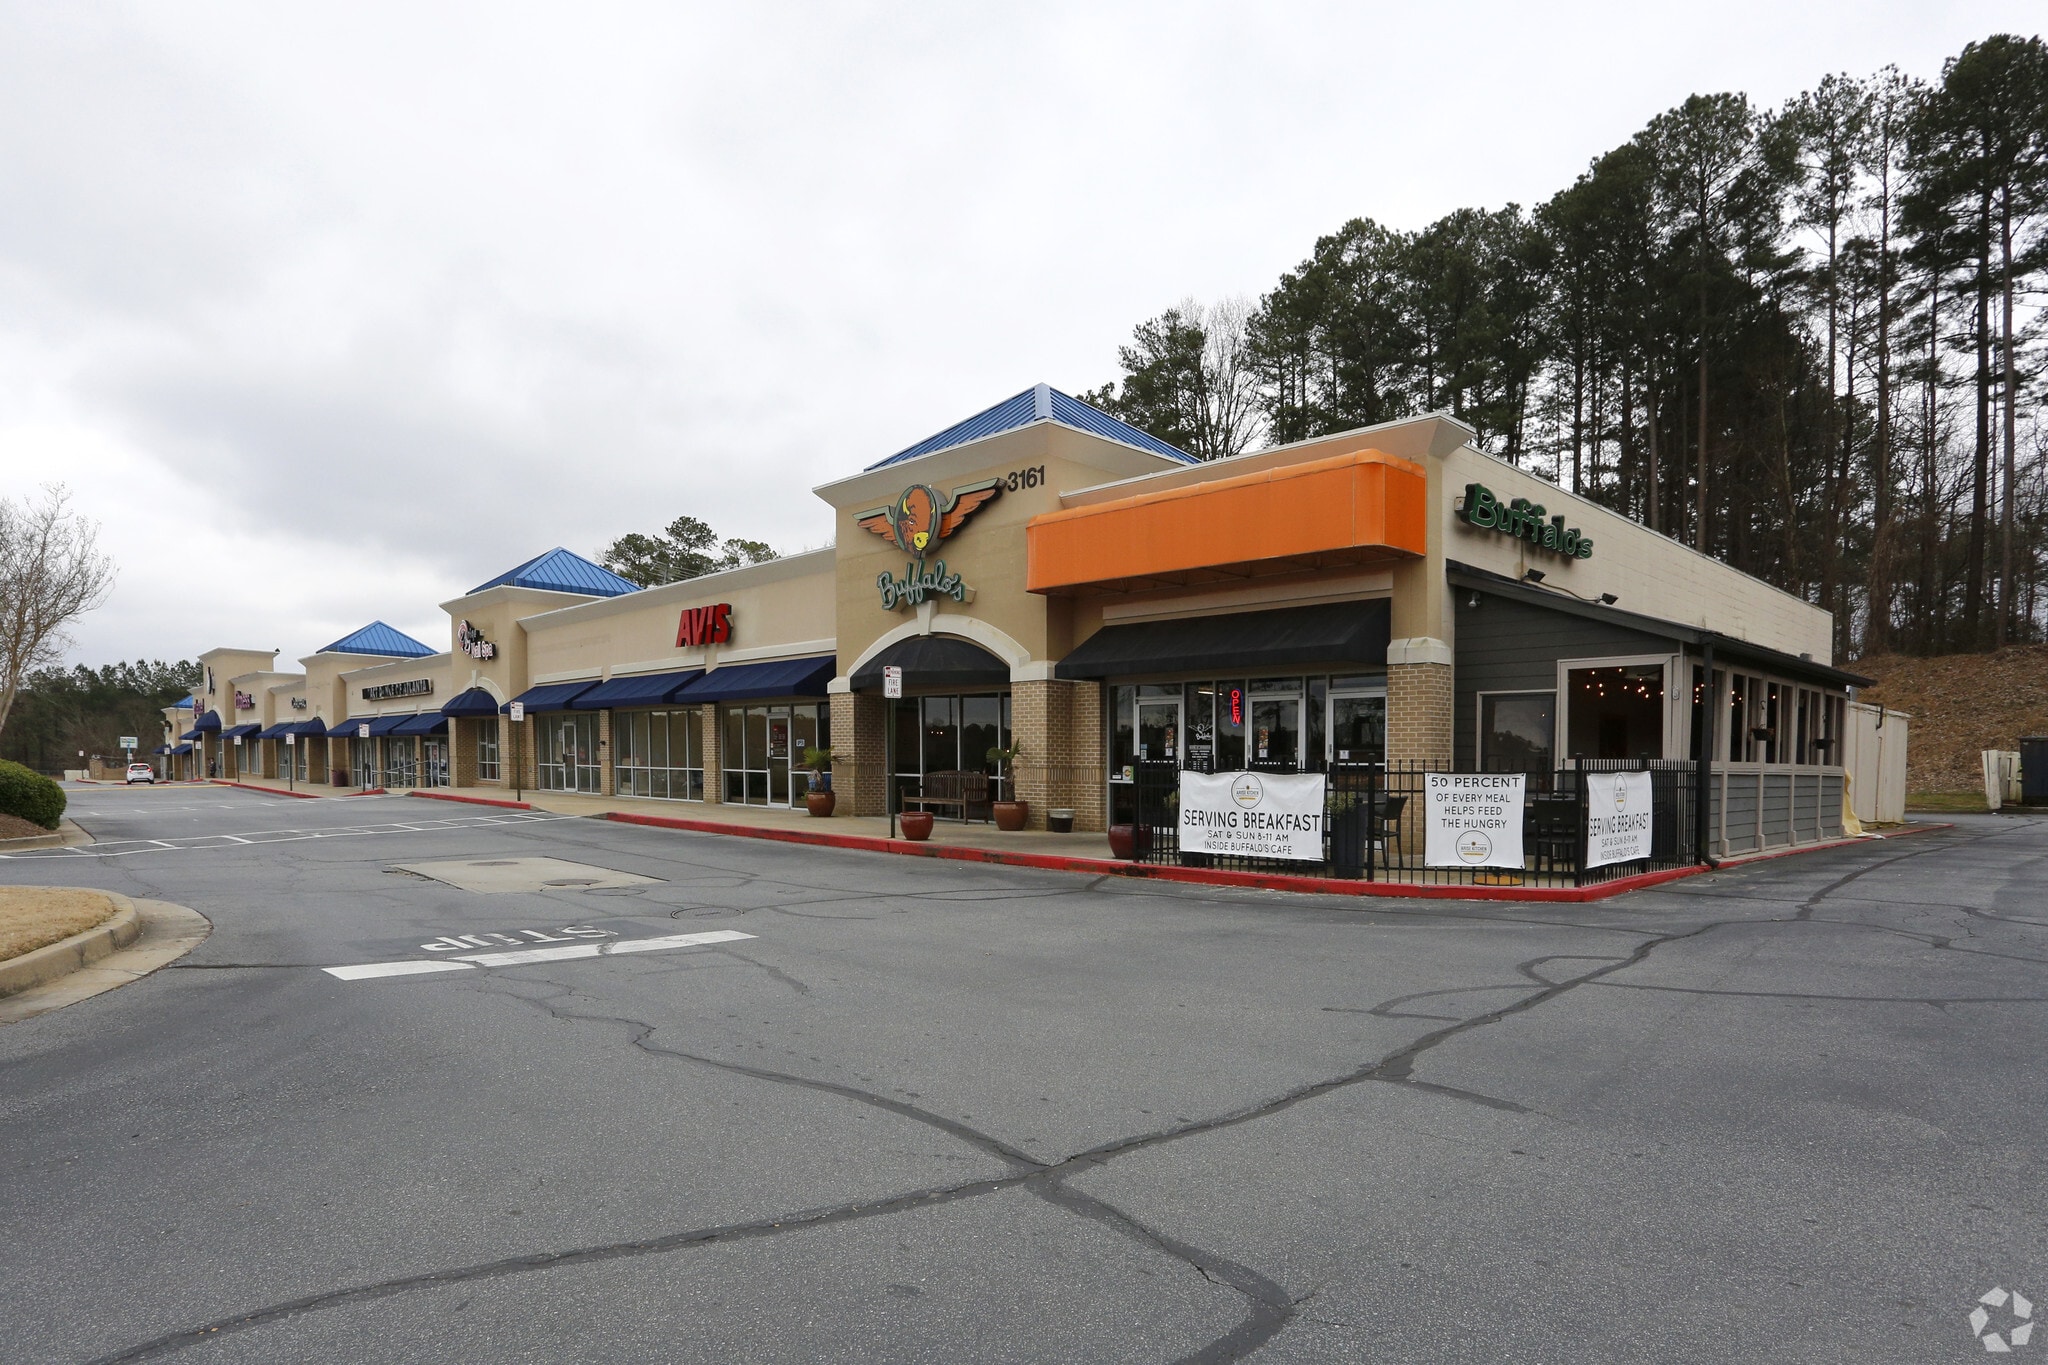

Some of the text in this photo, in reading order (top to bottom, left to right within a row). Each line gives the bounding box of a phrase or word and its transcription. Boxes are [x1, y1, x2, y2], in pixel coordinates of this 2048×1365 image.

[1007, 465, 1045, 492] 3161
[1465, 483, 1594, 560] Buffalo's
[877, 559, 966, 610] Buffalo's
[675, 603, 732, 648] AVIS
[482, 640, 494, 661] Spa
[888, 679, 899, 687] FIRE
[887, 687, 899, 695] LANE
[1231, 690, 1241, 724] OPEN
[1431, 777, 1520, 788] 50 PERCENT
[1436, 793, 1511, 803] OF EVERY MEAL
[1444, 806, 1503, 816] HELPS FEED
[1184, 809, 1320, 832] SERVING BREAKFAST
[1441, 818, 1507, 829] THE HUNGRY
[1590, 812, 1649, 836] SERVING BREAKFAST
[1207, 830, 1223, 839] SAT
[1226, 831, 1232, 839] &
[1236, 831, 1255, 840] SUN
[1275, 834, 1289, 842] AM
[1601, 838, 1609, 848] SAT
[1204, 841, 1293, 855] INSIDE BUFFALO'S CAFE
